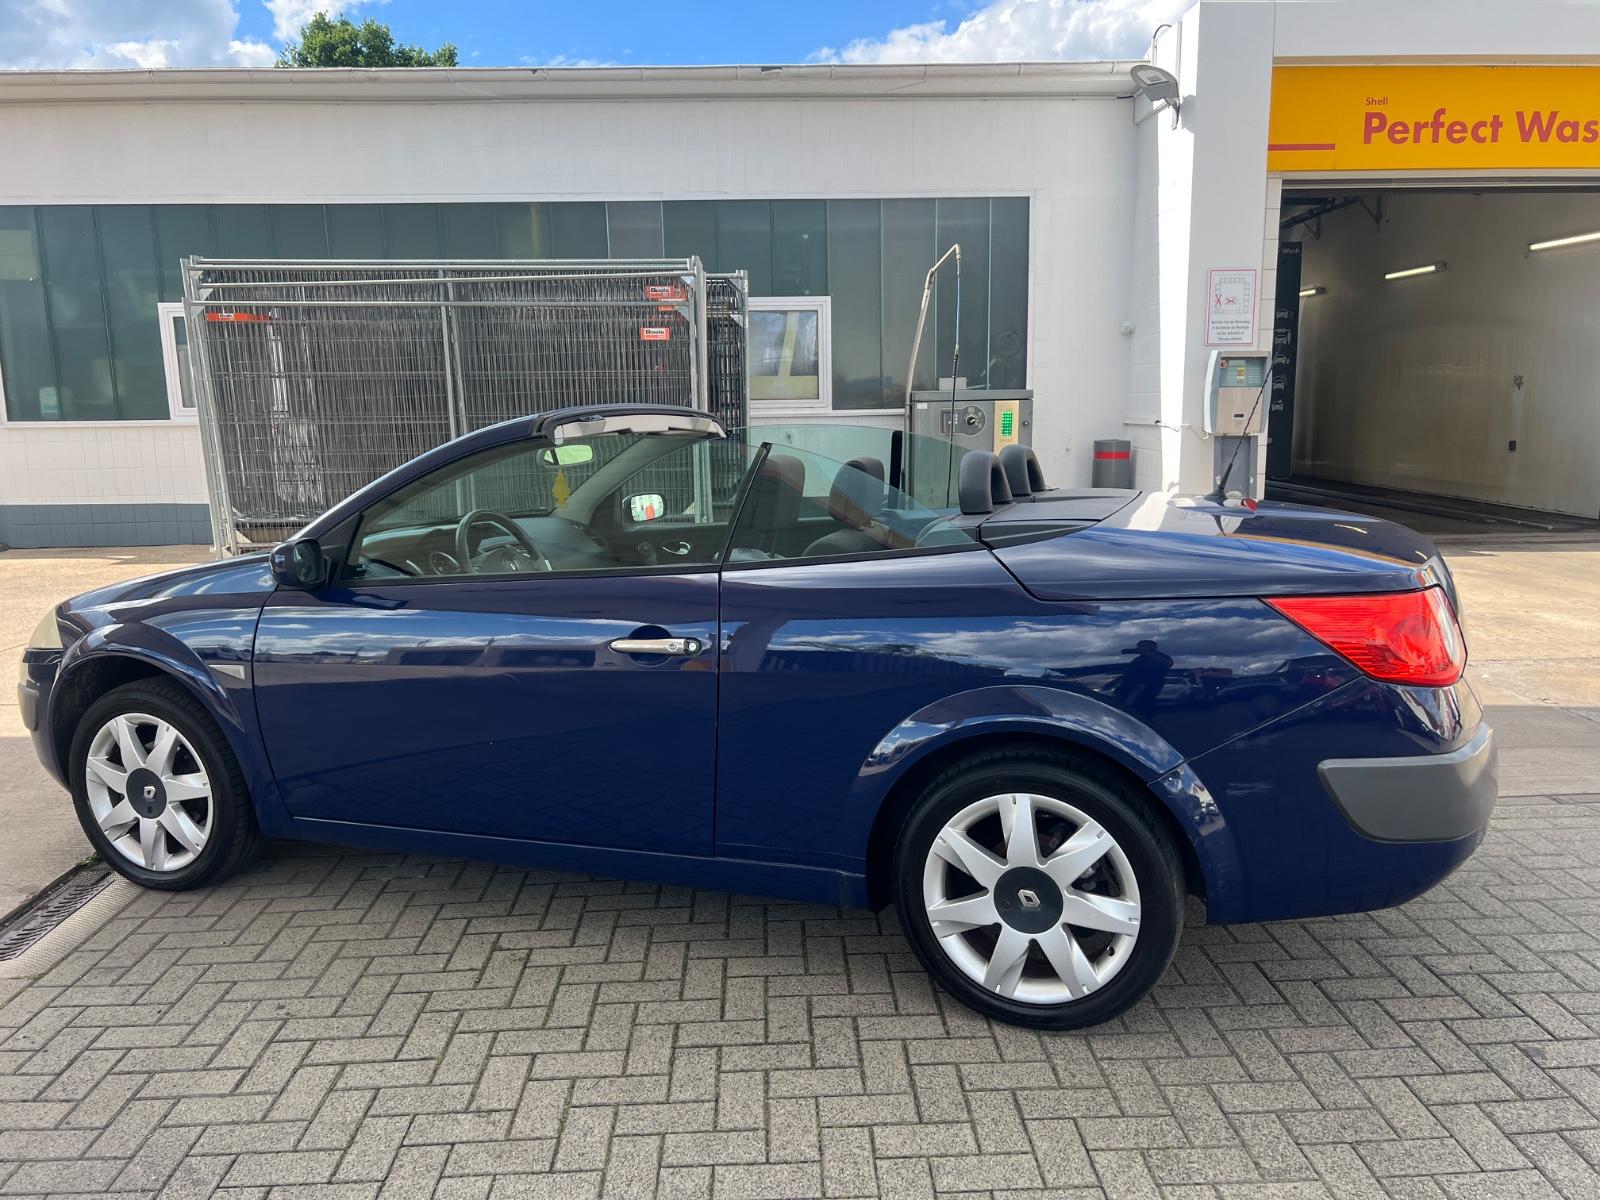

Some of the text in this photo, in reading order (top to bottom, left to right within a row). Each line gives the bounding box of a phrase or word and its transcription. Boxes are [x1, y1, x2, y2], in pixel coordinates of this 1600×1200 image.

[1365, 97, 1389, 106] Shell
[1363, 108, 1600, 144] Perfect Was
